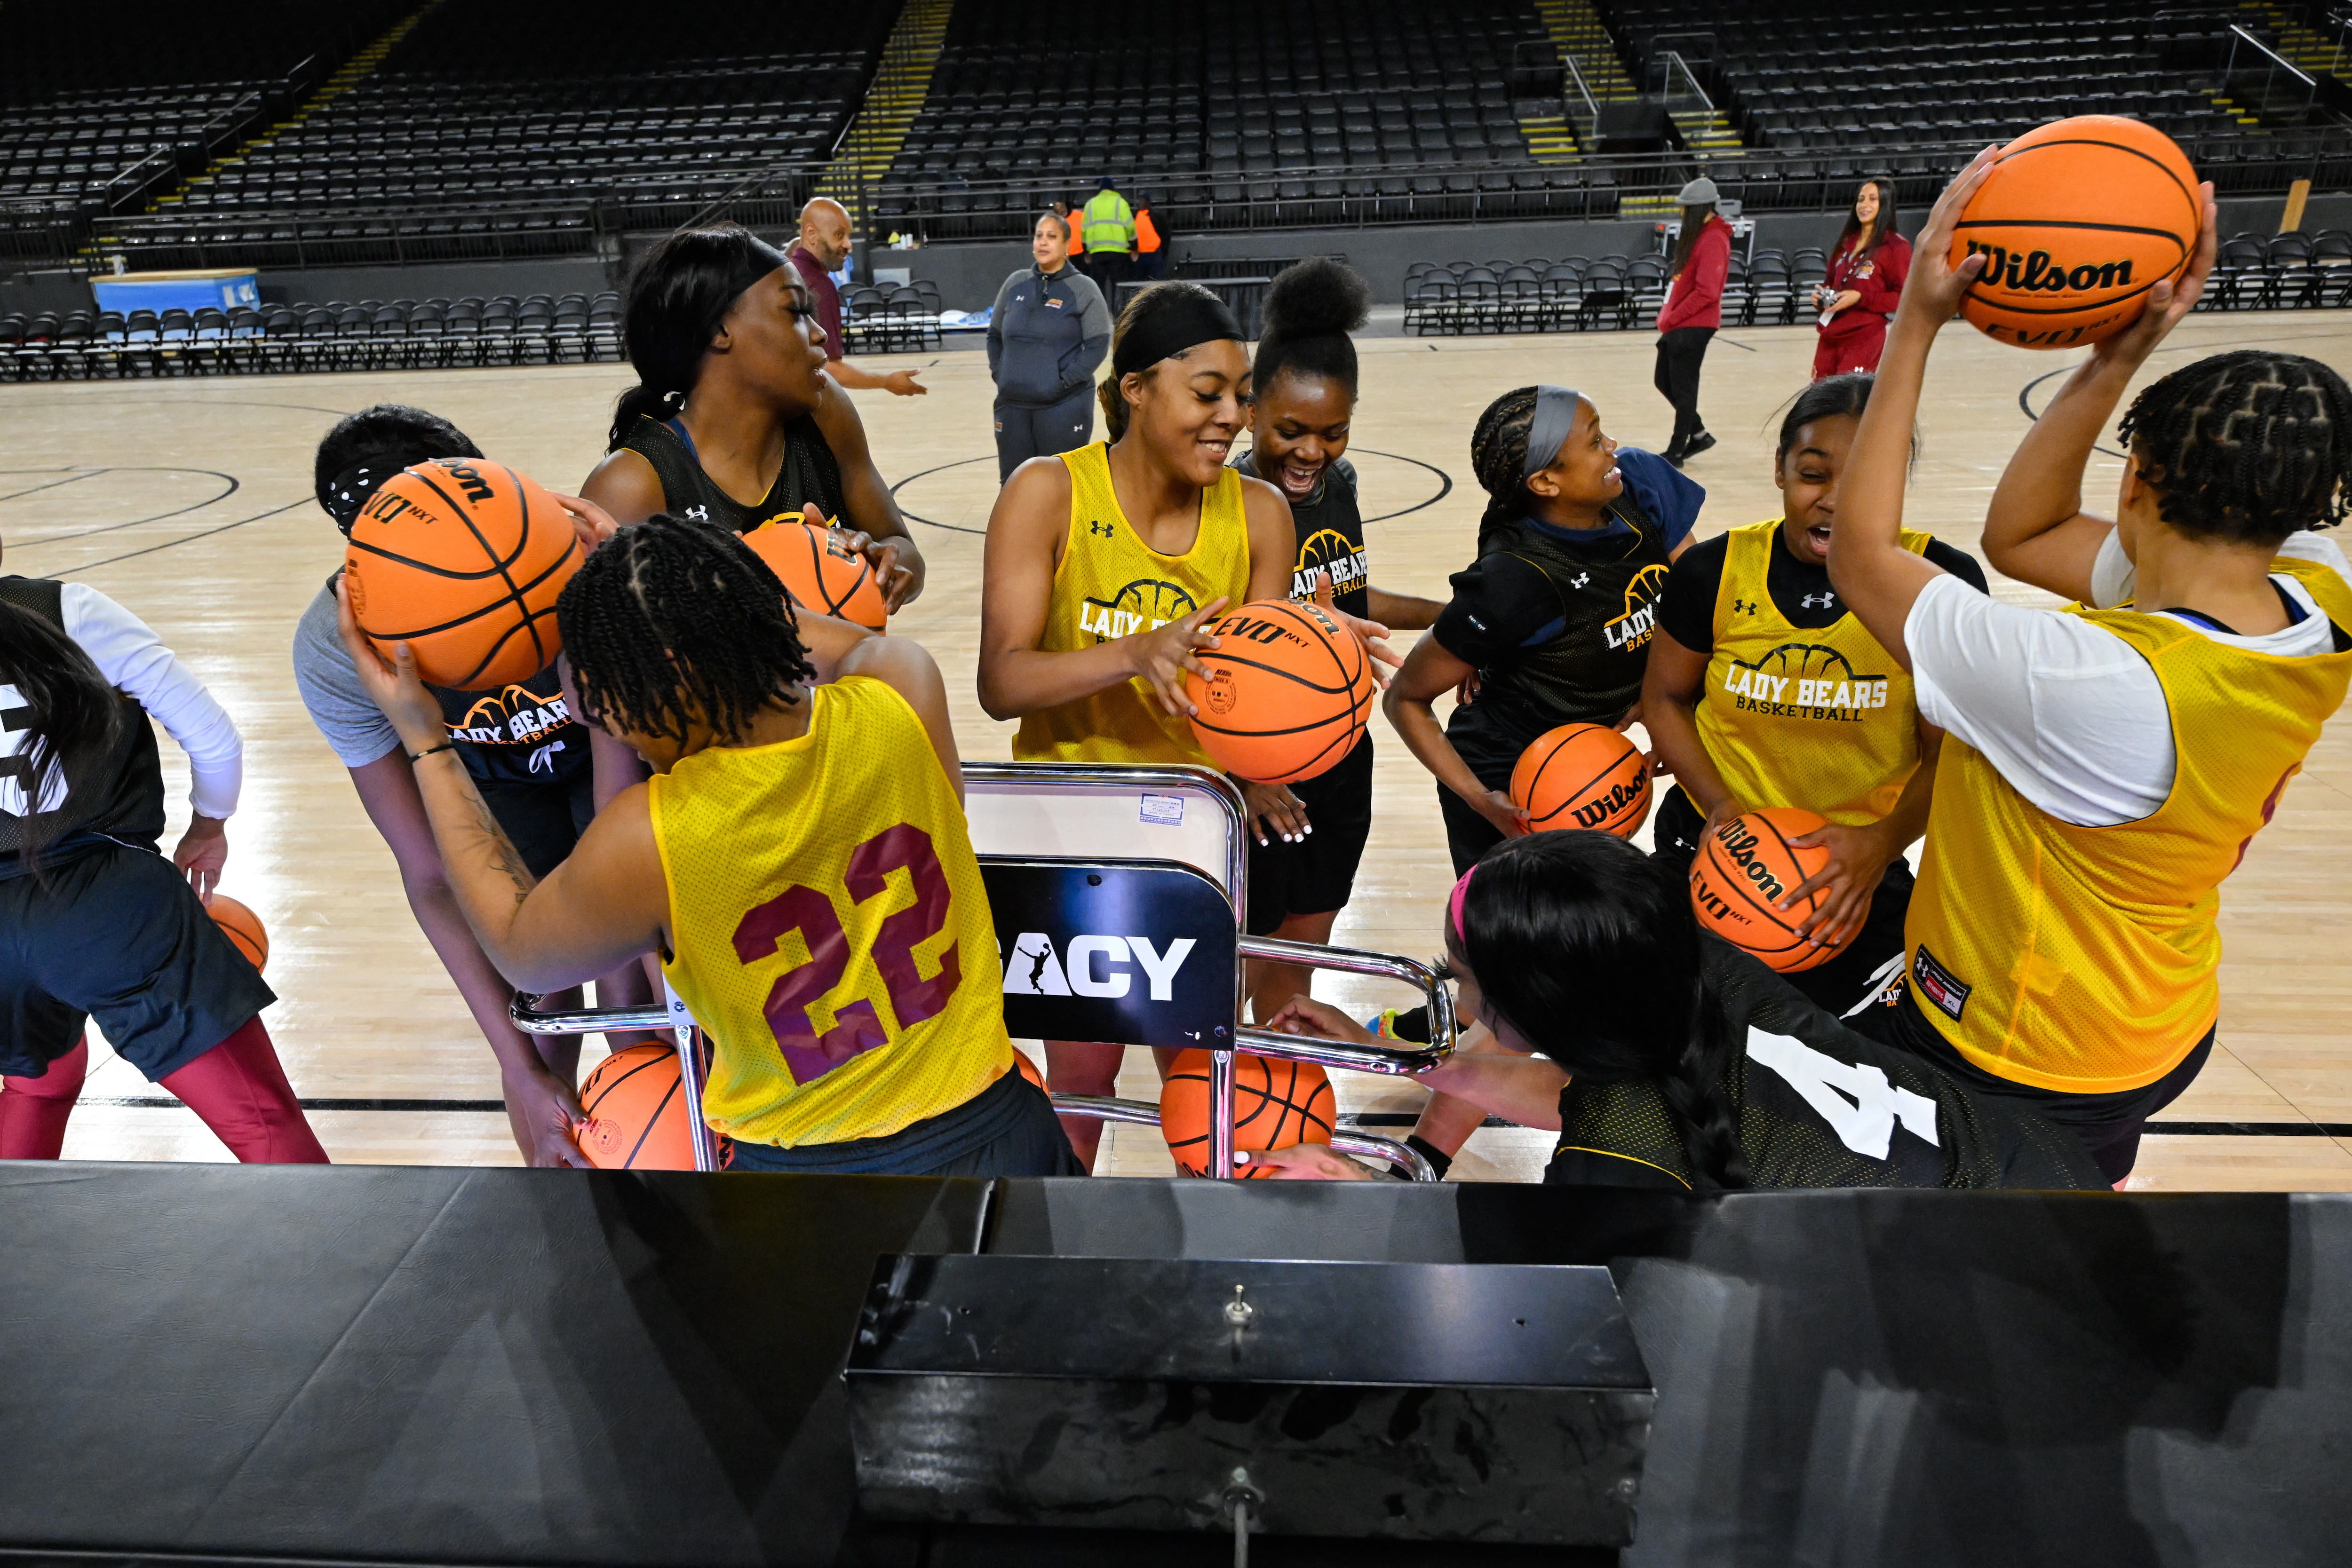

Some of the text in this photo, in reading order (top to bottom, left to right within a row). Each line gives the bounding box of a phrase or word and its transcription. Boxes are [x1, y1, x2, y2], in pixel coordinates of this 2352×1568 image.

[1967, 239, 2134, 291] Wilson
[407, 506, 439, 524] NXT
[1328, 550, 1368, 585] BEAR
[1080, 602, 1143, 639] LADY
[1213, 617, 1287, 644] EVO
[1285, 632, 1311, 648] NXT
[1604, 603, 1655, 649] LADY
[1724, 665, 1888, 708] LADY BEARS
[1736, 696, 1863, 721] BASKETBALL
[448, 697, 570, 742] ADY BEAR
[1570, 764, 1647, 829] Wilson
[1716, 817, 1786, 903] Wilson
[1692, 870, 1753, 925] EVO NXT
[731, 822, 963, 1087] 22
[996, 932, 1197, 1001] ACY
[1926, 979, 1944, 999] AUTHENTIC
[1931, 969, 1943, 982] UNDER
[1942, 981, 1963, 996] ARMOUR
[1947, 999, 1955, 1008] XL
[1746, 1024, 1941, 1161] 4
